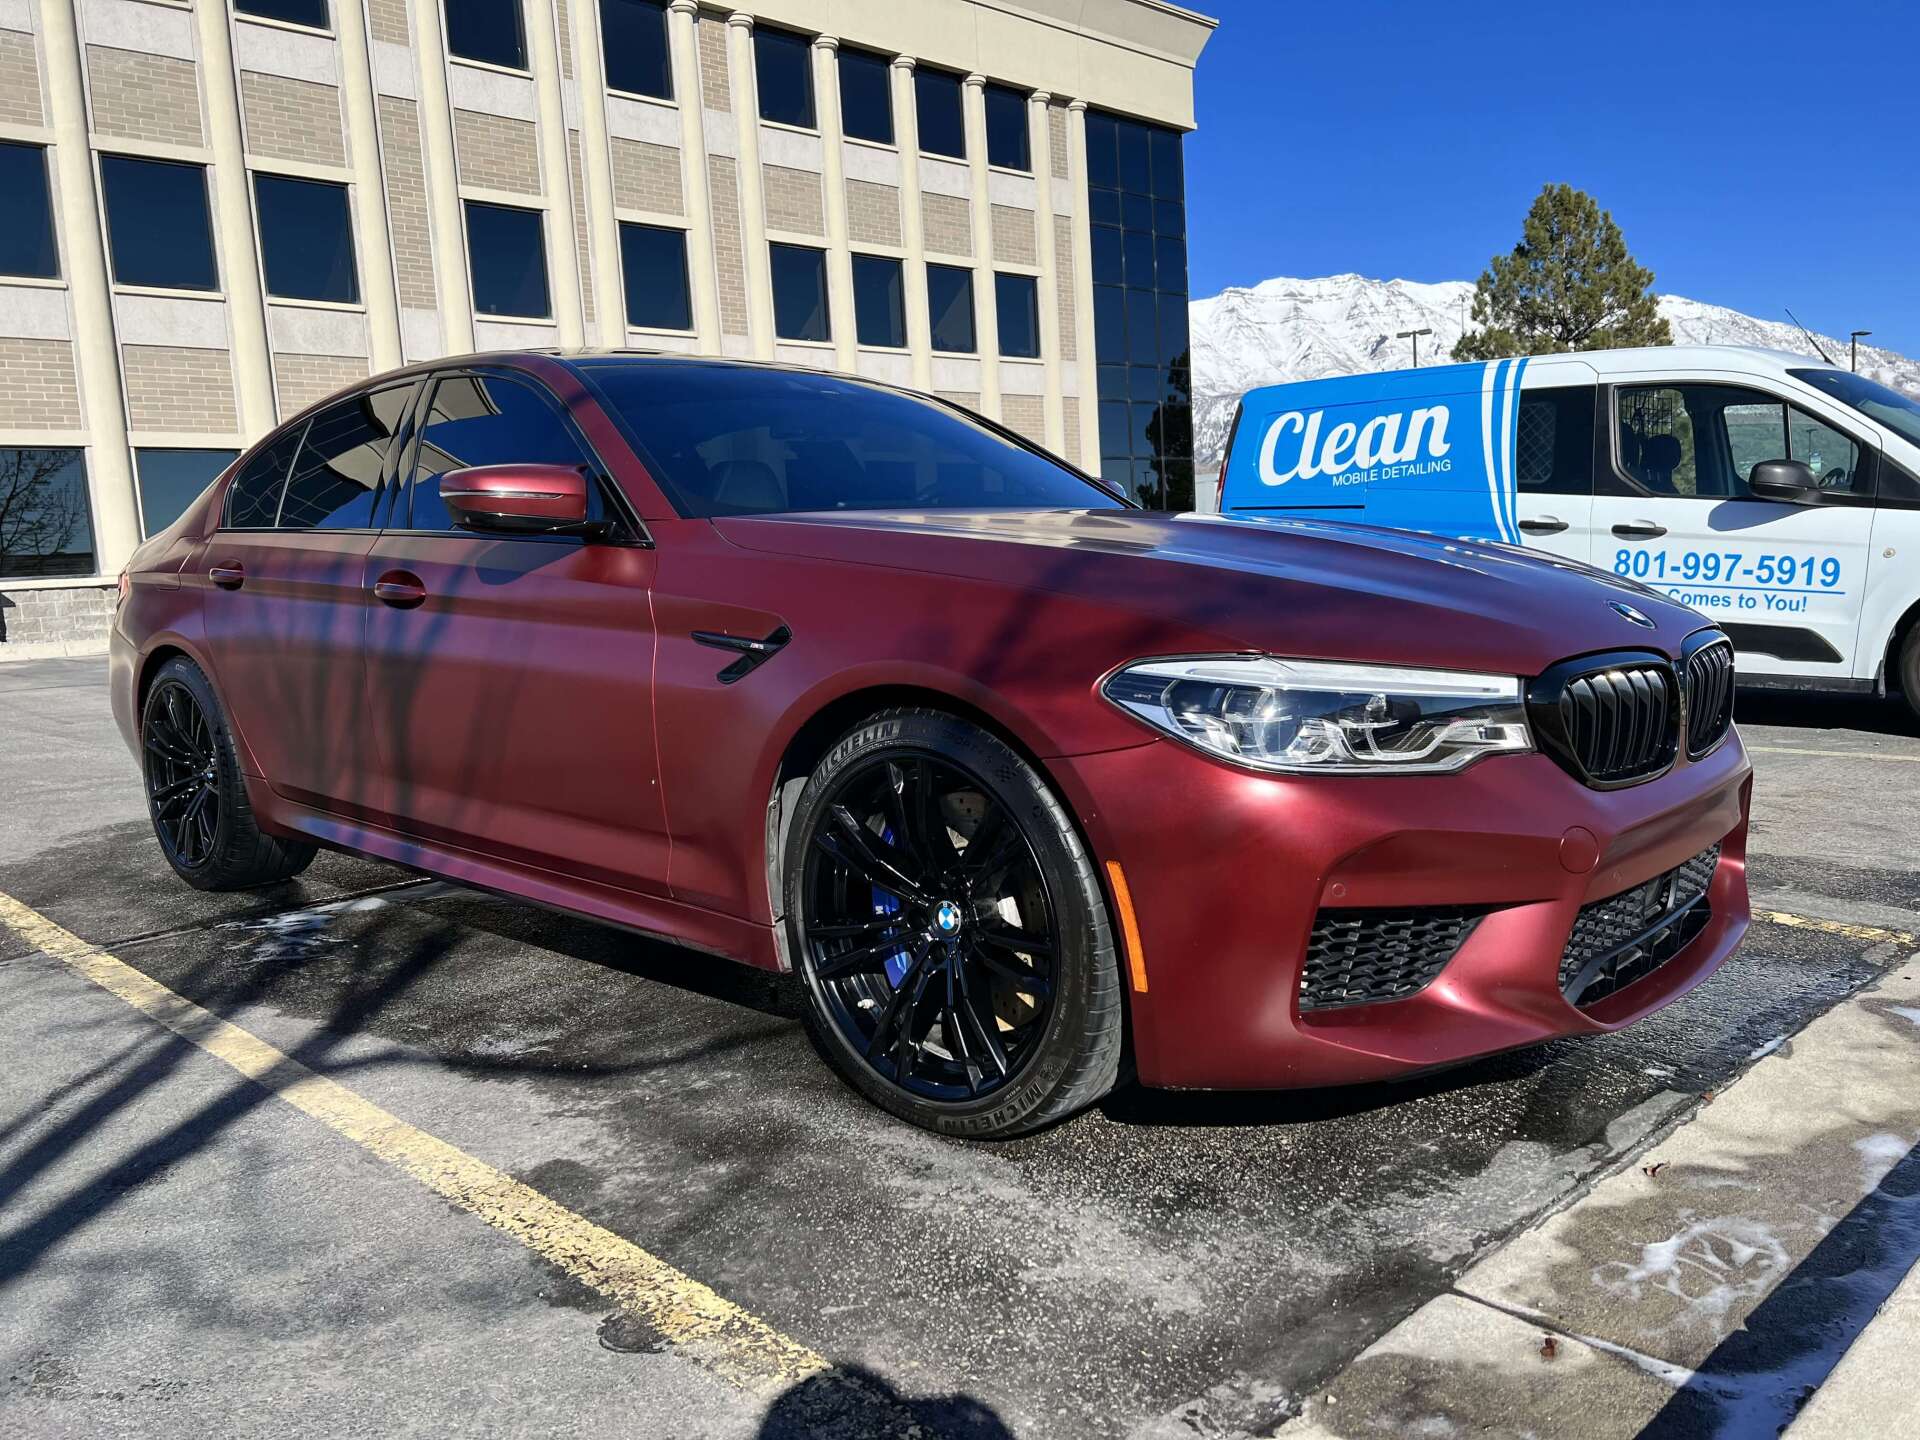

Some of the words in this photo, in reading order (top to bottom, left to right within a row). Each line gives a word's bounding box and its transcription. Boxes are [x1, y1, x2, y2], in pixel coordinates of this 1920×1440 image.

[1259, 405, 1450, 486] Clean
[1332, 469, 1378, 487] MOBILE
[1382, 459, 1451, 480] DETAILING
[1614, 549, 1841, 588] 801-997-5919
[1738, 593, 1757, 610] to
[1764, 594, 1807, 612] You!
[814, 721, 895, 786] MICHELIN
[943, 1081, 1045, 1131] MICHELIN
